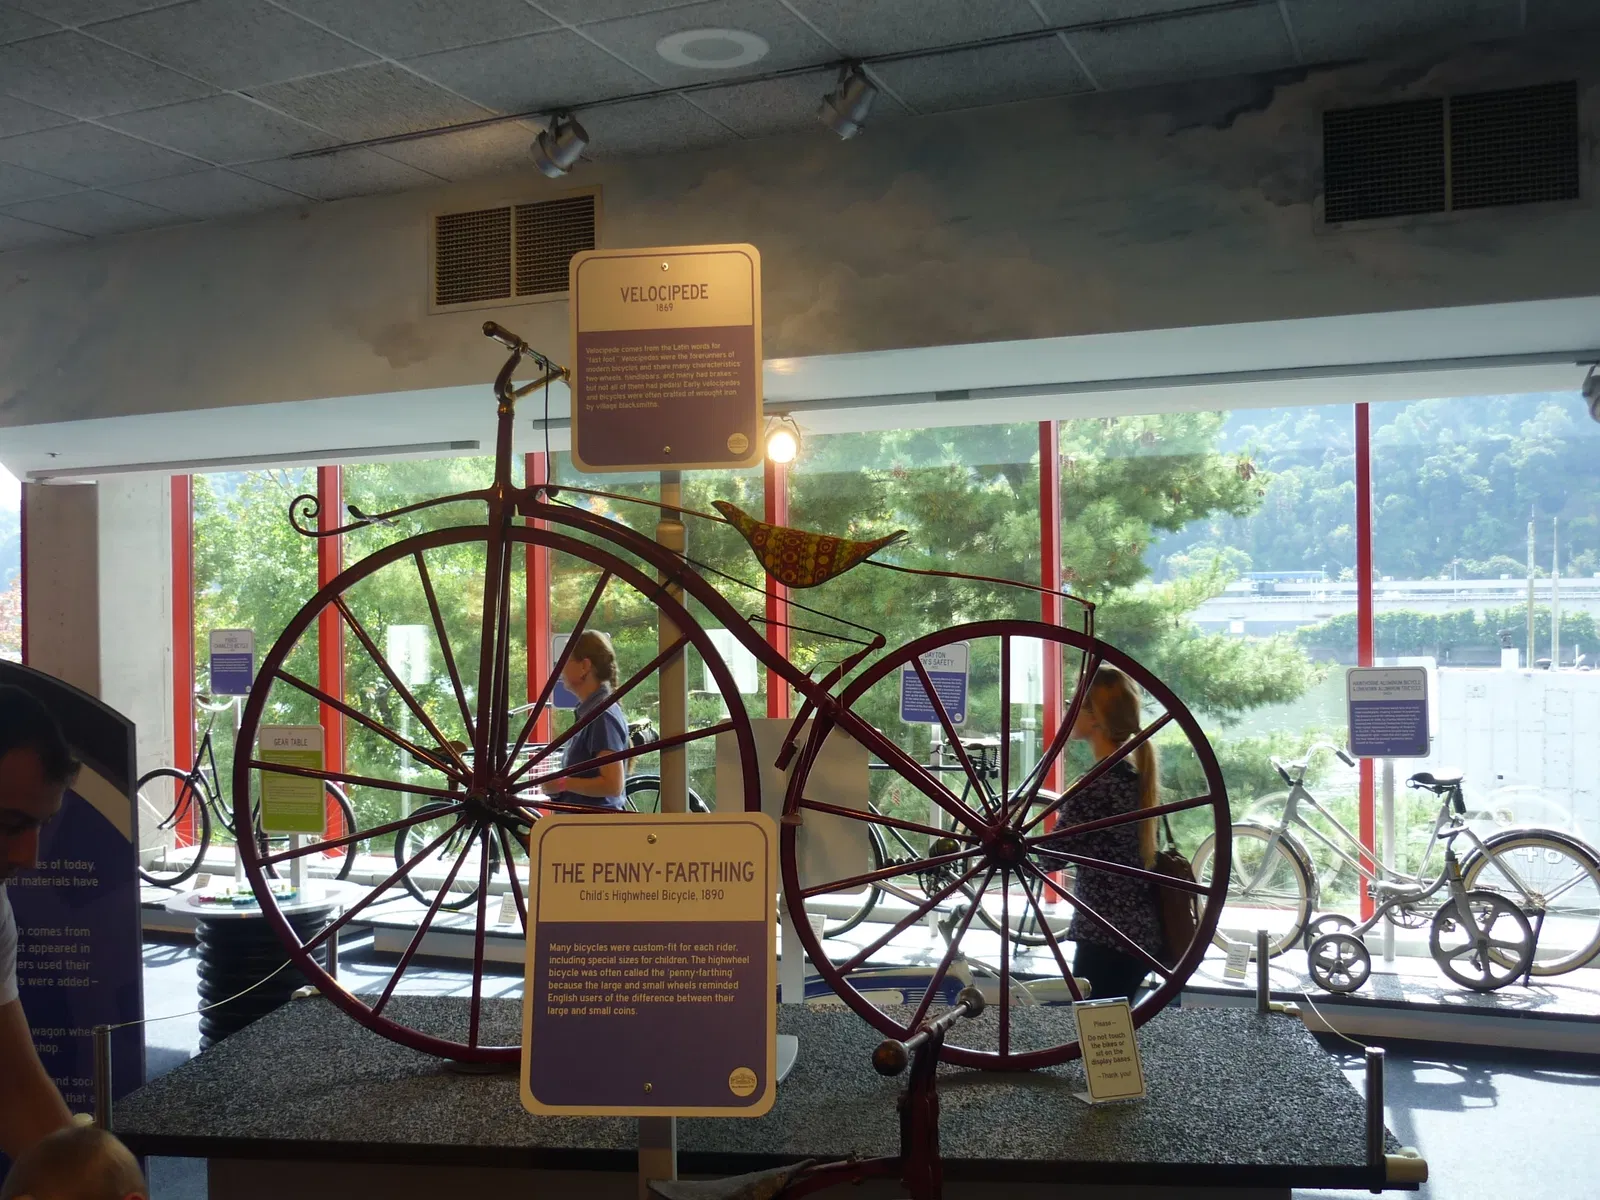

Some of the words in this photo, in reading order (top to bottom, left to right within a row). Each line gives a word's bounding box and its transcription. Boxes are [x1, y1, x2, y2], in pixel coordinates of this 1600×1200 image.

[620, 284, 708, 303] VELOCIPEDE
[656, 303, 674, 312] 1869
[586, 404, 594, 412] by
[274, 738, 289, 746] GEAR
[291, 738, 308, 746] TABLE
[51, 859, 60, 869] of
[552, 863, 585, 883] THE
[593, 861, 754, 883] PENNY-FARTHING
[5, 876, 18, 886] nd
[22, 876, 70, 886] materials
[74, 876, 99, 886] have
[580, 890, 609, 901] Child's
[613, 890, 659, 904] Highwheel
[662, 890, 698, 904] Bicycle,
[702, 889, 725, 900] 1890
[28, 928, 62, 937] comes
[65, 927, 91, 937] from
[29, 943, 77, 955] appeared
[81, 943, 91, 953] in
[549, 943, 571, 954] Many
[574, 943, 608, 954] bicycles
[633, 943, 677, 952] custom-fit
[680, 943, 692, 952] for
[694, 943, 714, 952] each
[38, 960, 62, 970] used
[66, 960, 91, 970] their
[549, 956, 586, 966] including
[588, 956, 617, 967] special
[619, 956, 639, 964] sizes
[641, 956, 653, 964] for
[691, 956, 706, 964] The
[708, 956, 750, 966] highwheel
[549, 968, 579, 979] bicycle
[600, 968, 622, 977] often
[624, 968, 649, 977] called
[652, 968, 665, 977] the
[28, 978, 54, 986] were
[57, 977, 90, 987] added
[549, 981, 583, 989] because
[585, 981, 599, 989] the
[601, 981, 622, 991] large
[624, 981, 640, 989] and
[642, 981, 665, 989] small
[667, 981, 696, 989] wheels
[699, 981, 739, 989] reminded
[548, 993, 578, 1004] English
[605, 994, 614, 1002] of
[616, 994, 630, 1002] the
[632, 994, 674, 1002] difference
[677, 994, 713, 1002] between
[715, 994, 735, 1002] their
[548, 1006, 569, 1016] large
[571, 1006, 587, 1015] and
[589, 1006, 612, 1015] small
[614, 1007, 638, 1015] coins.
[32, 1028, 66, 1039] wagon
[65, 1093, 86, 1103] that
